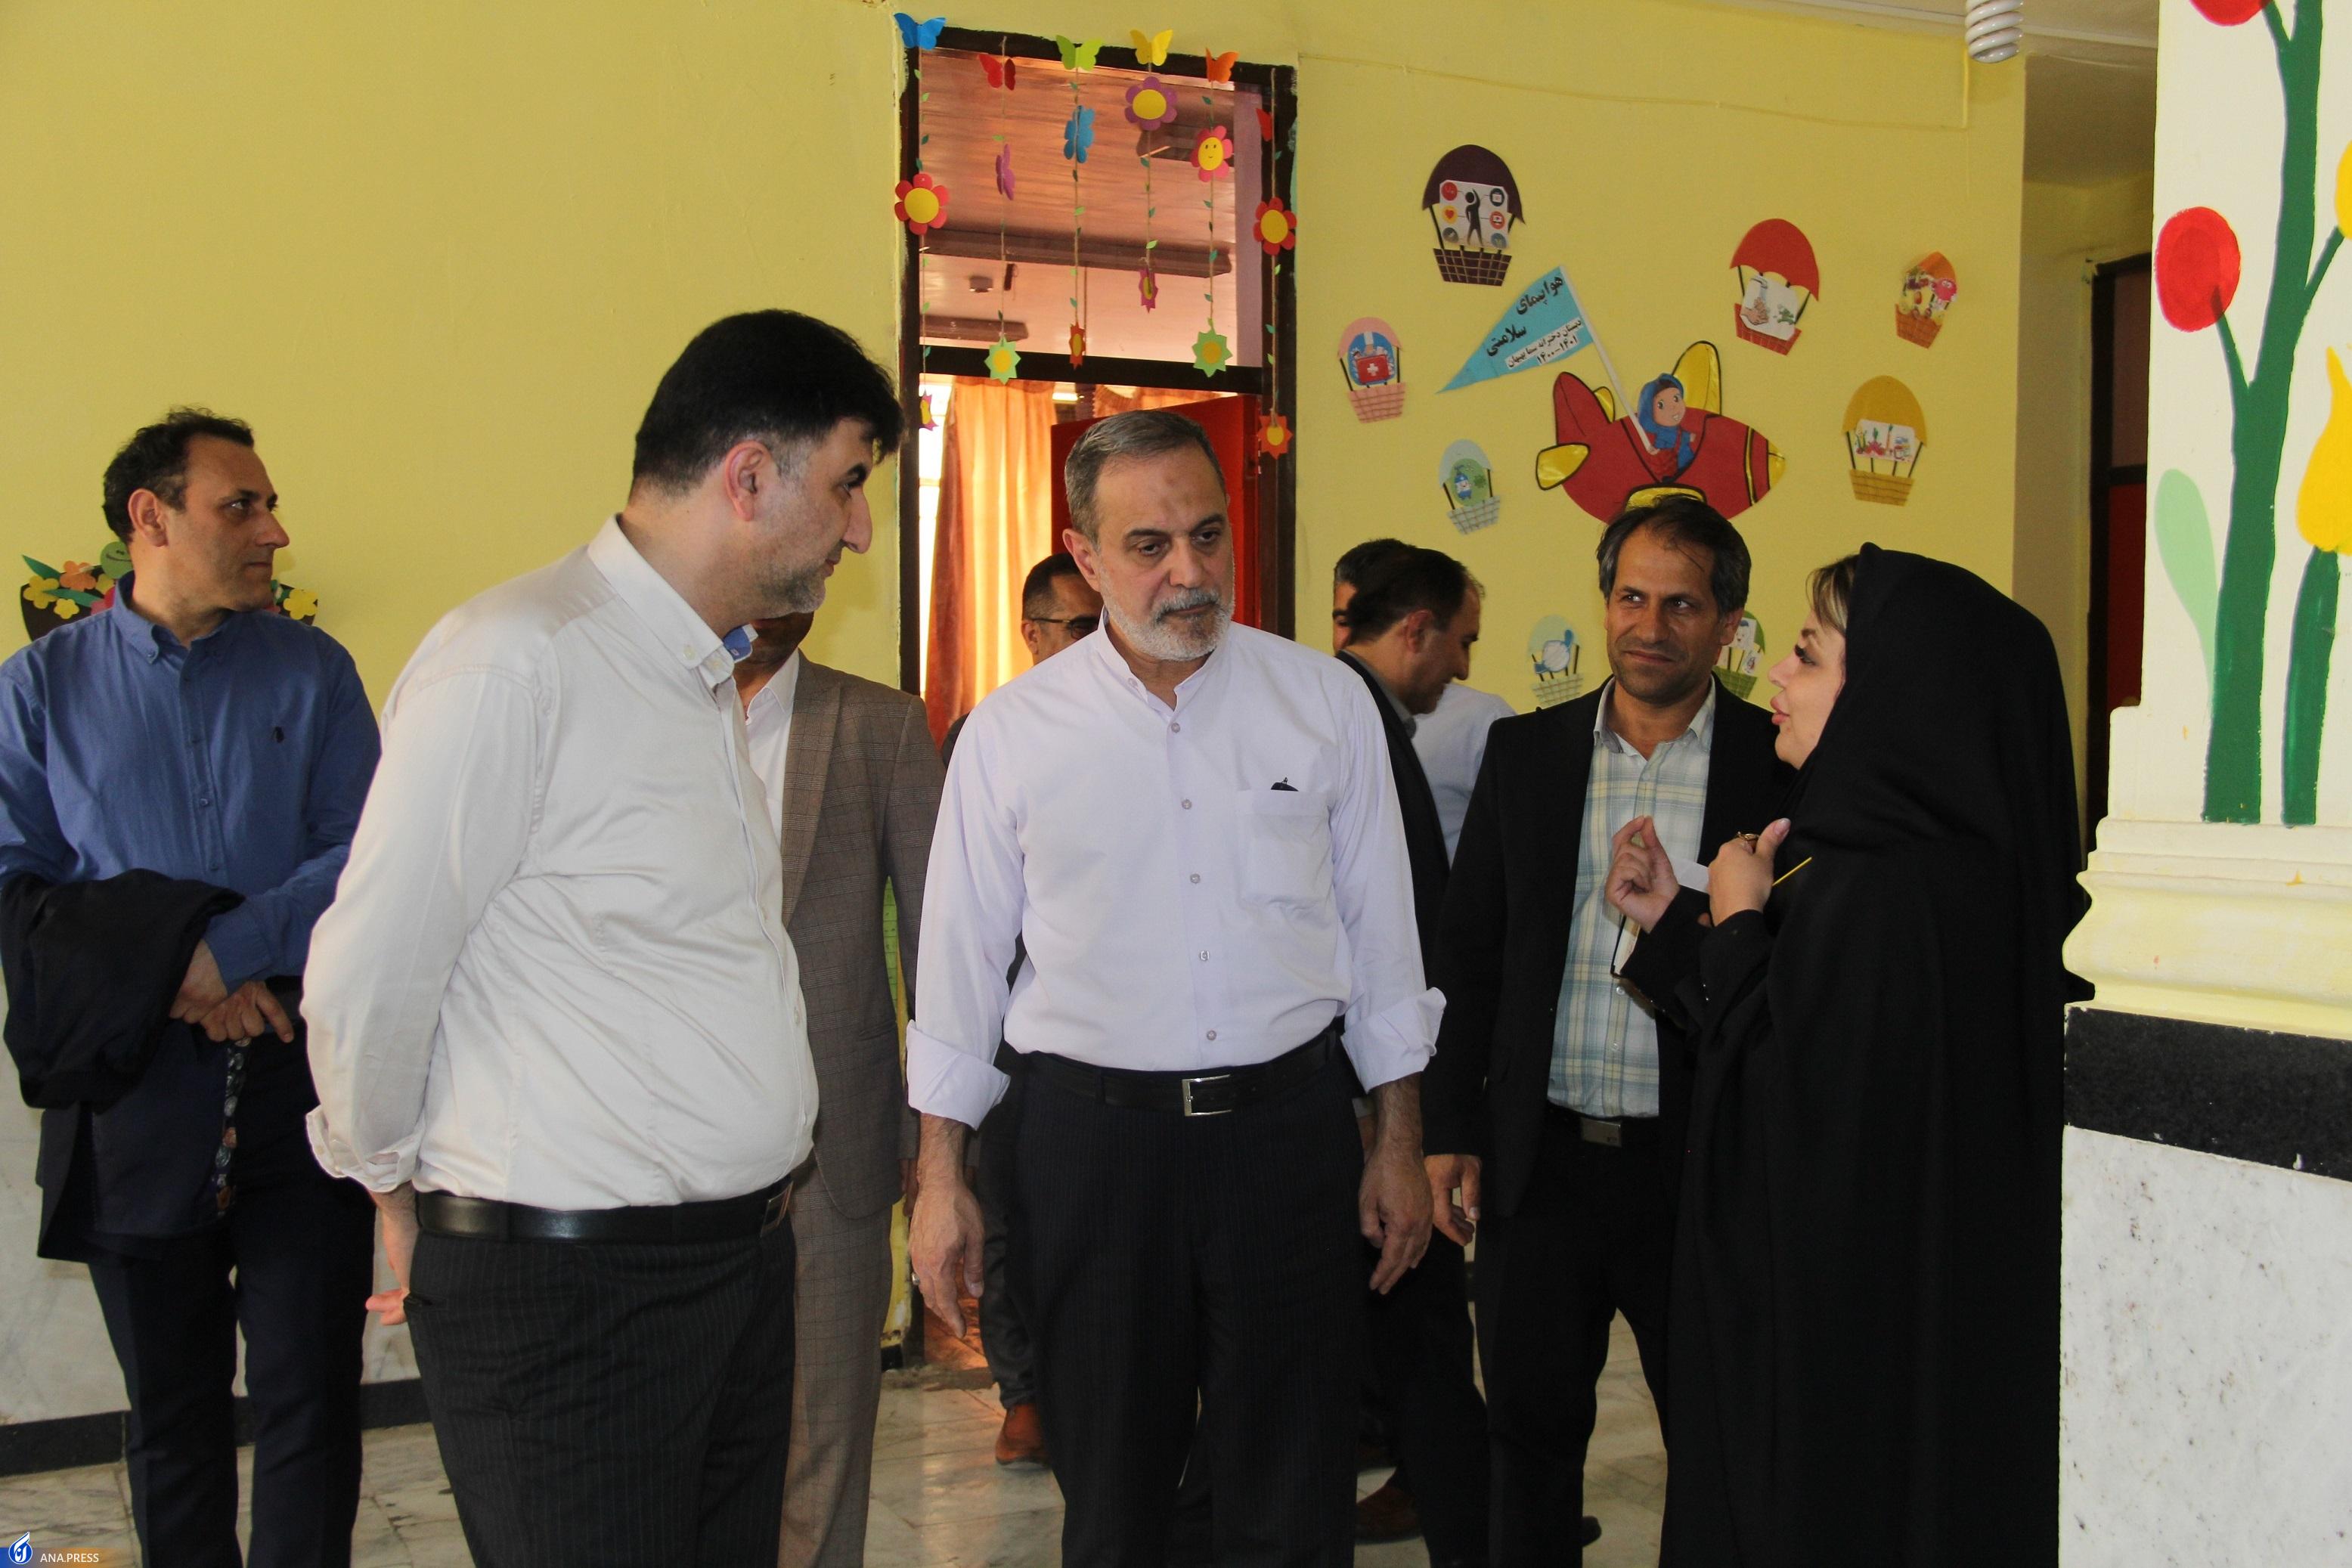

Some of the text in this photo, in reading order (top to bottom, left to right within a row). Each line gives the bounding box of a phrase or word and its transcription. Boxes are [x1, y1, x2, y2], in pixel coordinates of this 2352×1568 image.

[1516, 277, 1563, 315] هواپیمای
[1486, 324, 1527, 356] سلامتی
[1563, 320, 1582, 336] دبستان
